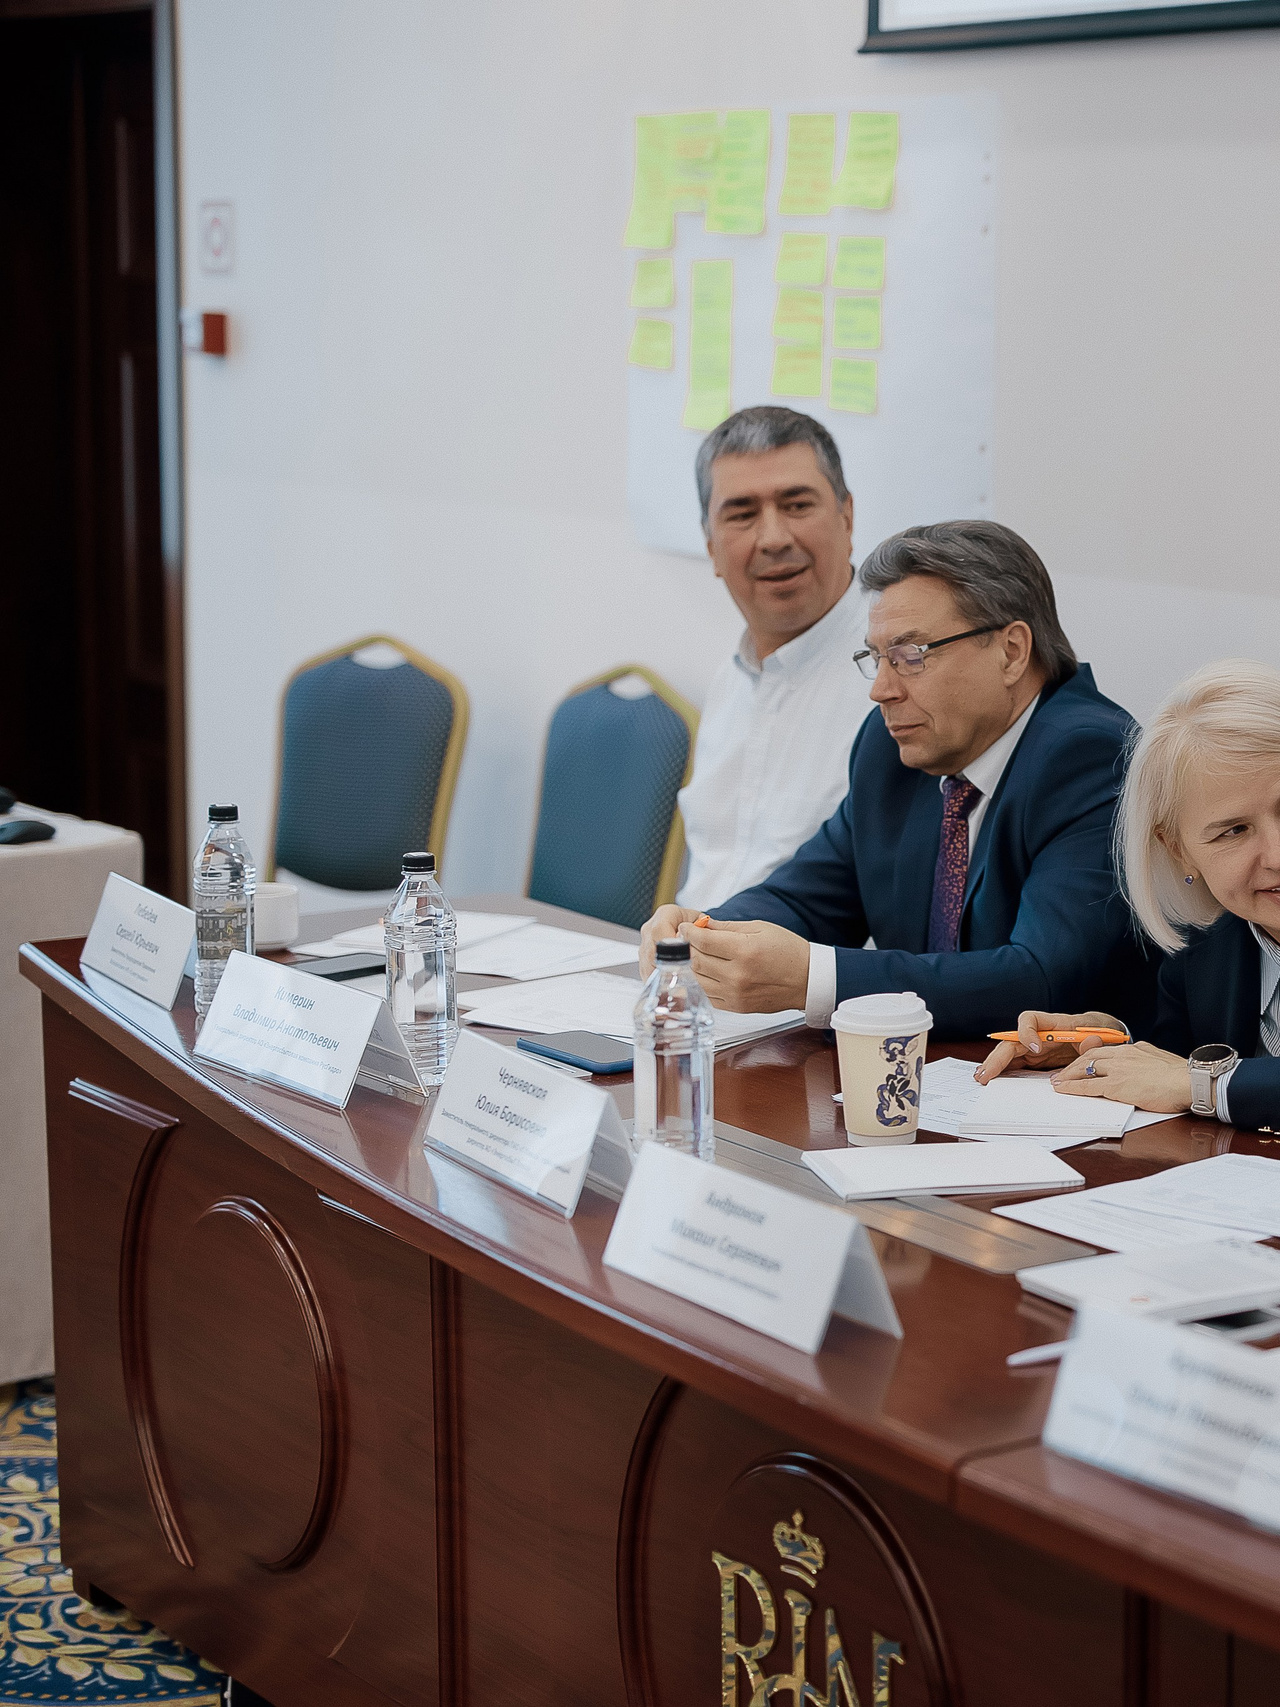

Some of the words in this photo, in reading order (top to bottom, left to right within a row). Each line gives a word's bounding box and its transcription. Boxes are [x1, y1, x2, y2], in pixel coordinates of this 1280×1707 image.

[274, 986, 315, 1010] Кимерин
[232, 1003, 276, 1031] Владимир
[275, 1019, 340, 1051] Анатольевич
[498, 1066, 548, 1099] Чернявская
[474, 1093, 500, 1116] Юлия
[499, 1104, 546, 1133] Борисовна
